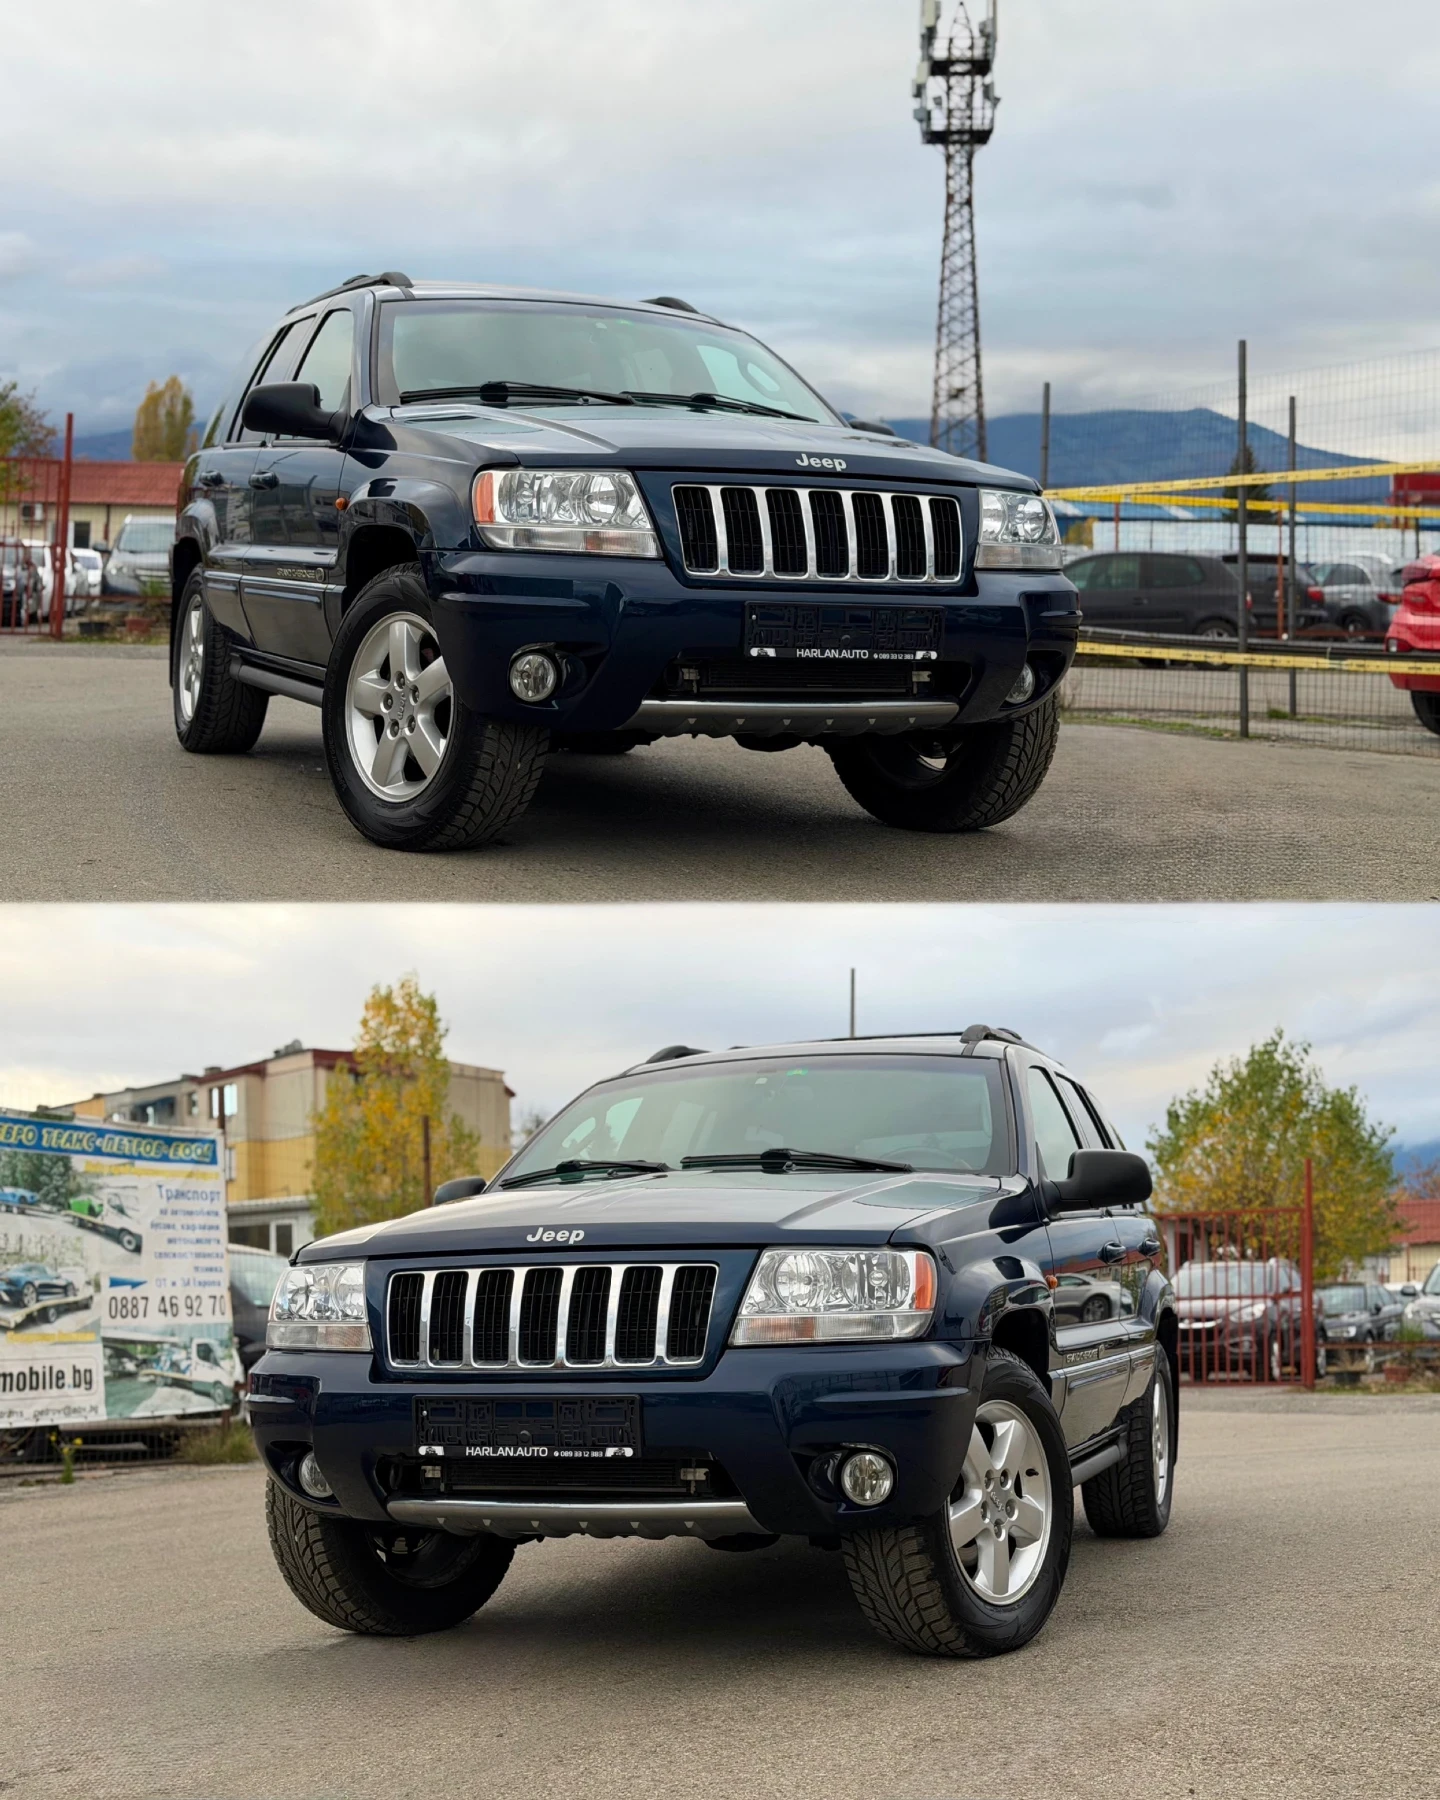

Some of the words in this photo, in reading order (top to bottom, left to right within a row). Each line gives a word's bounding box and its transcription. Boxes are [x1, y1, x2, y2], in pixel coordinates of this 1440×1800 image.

[795, 453, 847, 472] Jeep
[796, 648, 869, 659] HARLAN.AUTO
[156, 1184, 221, 1204] Транспорт
[526, 1226, 585, 1245] Jeep
[109, 1296, 149, 1319] 0887
[158, 1295, 179, 1317] 46
[185, 1295, 203, 1317] 92
[209, 1295, 226, 1316] 70
[465, 1446, 548, 1457] HARLAN.AUTO
